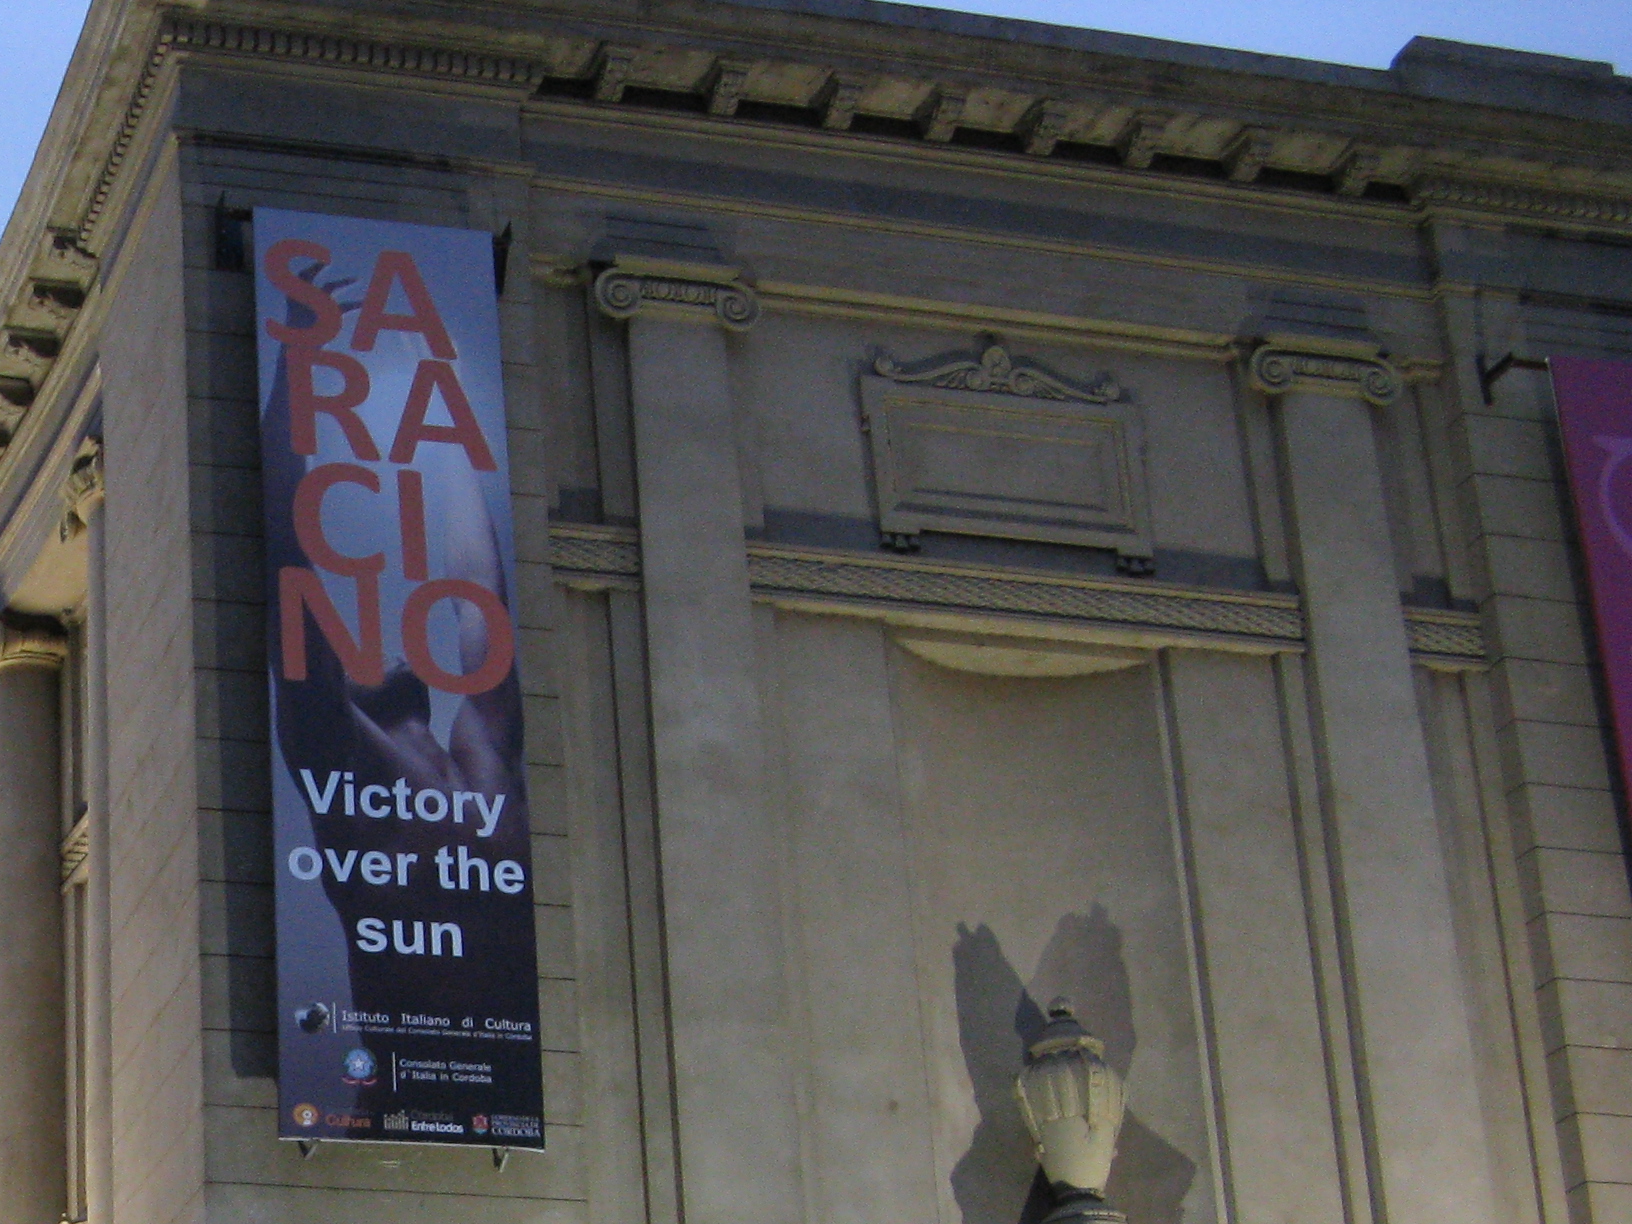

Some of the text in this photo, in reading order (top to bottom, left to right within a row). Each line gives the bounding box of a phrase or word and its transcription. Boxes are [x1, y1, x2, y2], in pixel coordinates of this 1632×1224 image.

[264, 238, 457, 360] SA
[285, 344, 498, 471] RA
[293, 462, 429, 581] CI
[279, 563, 515, 695] NO
[299, 768, 506, 837] Victory
[288, 845, 525, 894] over the
[356, 916, 463, 957] sun
[342, 1010, 532, 1031] Istituto Italiano di Cultura
[399, 1059, 491, 1072] Consolato Generale
[326, 1114, 371, 1128] Cultura
